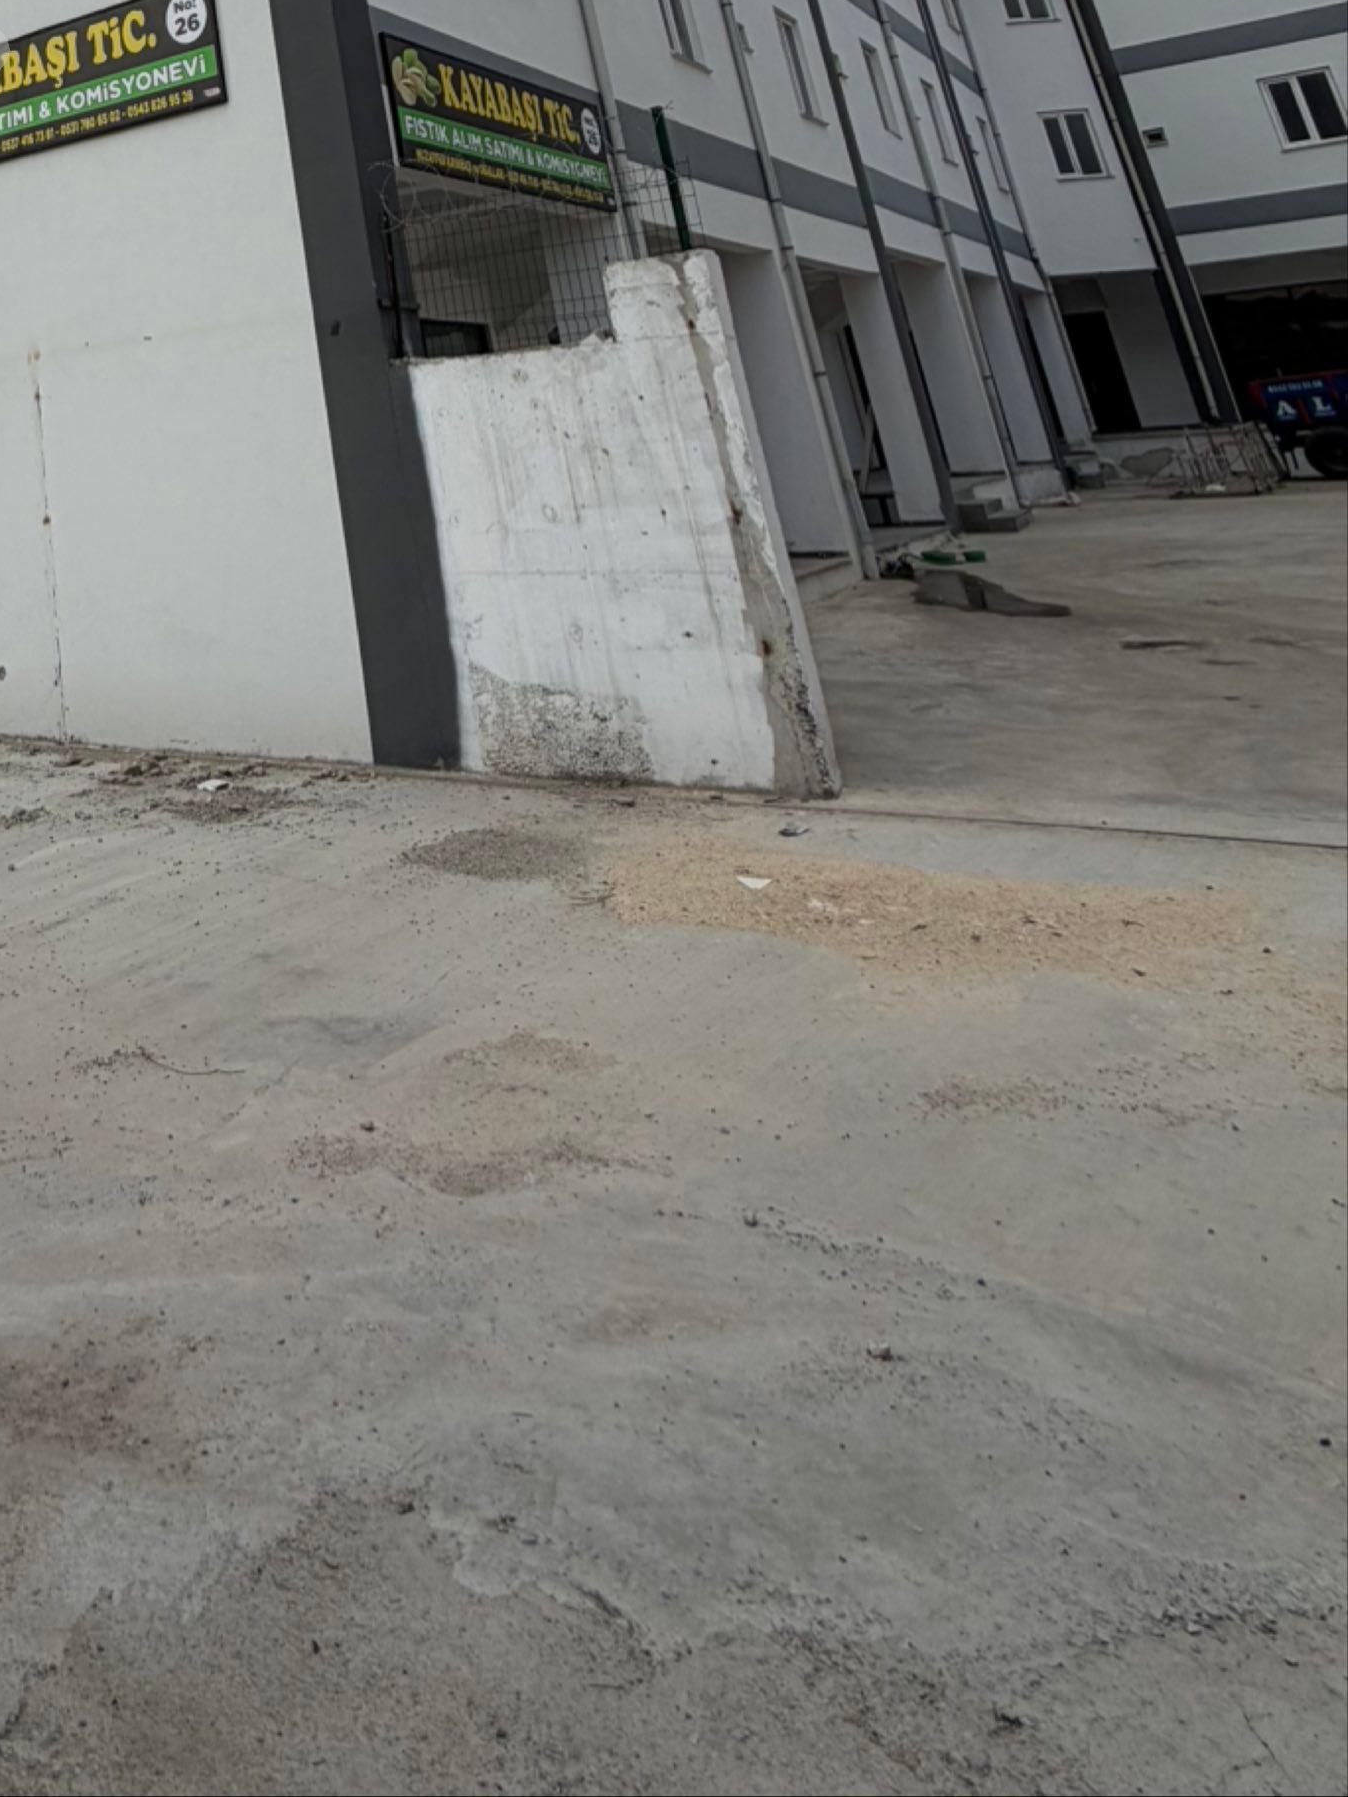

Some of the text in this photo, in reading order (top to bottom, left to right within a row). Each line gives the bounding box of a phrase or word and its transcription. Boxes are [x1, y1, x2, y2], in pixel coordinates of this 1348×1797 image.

[174, 13, 200, 36] 26
[38, 100, 52, 119] &
[437, 63, 544, 142] KAYABAŞI
[404, 115, 449, 144] FISTIK
[452, 129, 483, 153] ALIM
